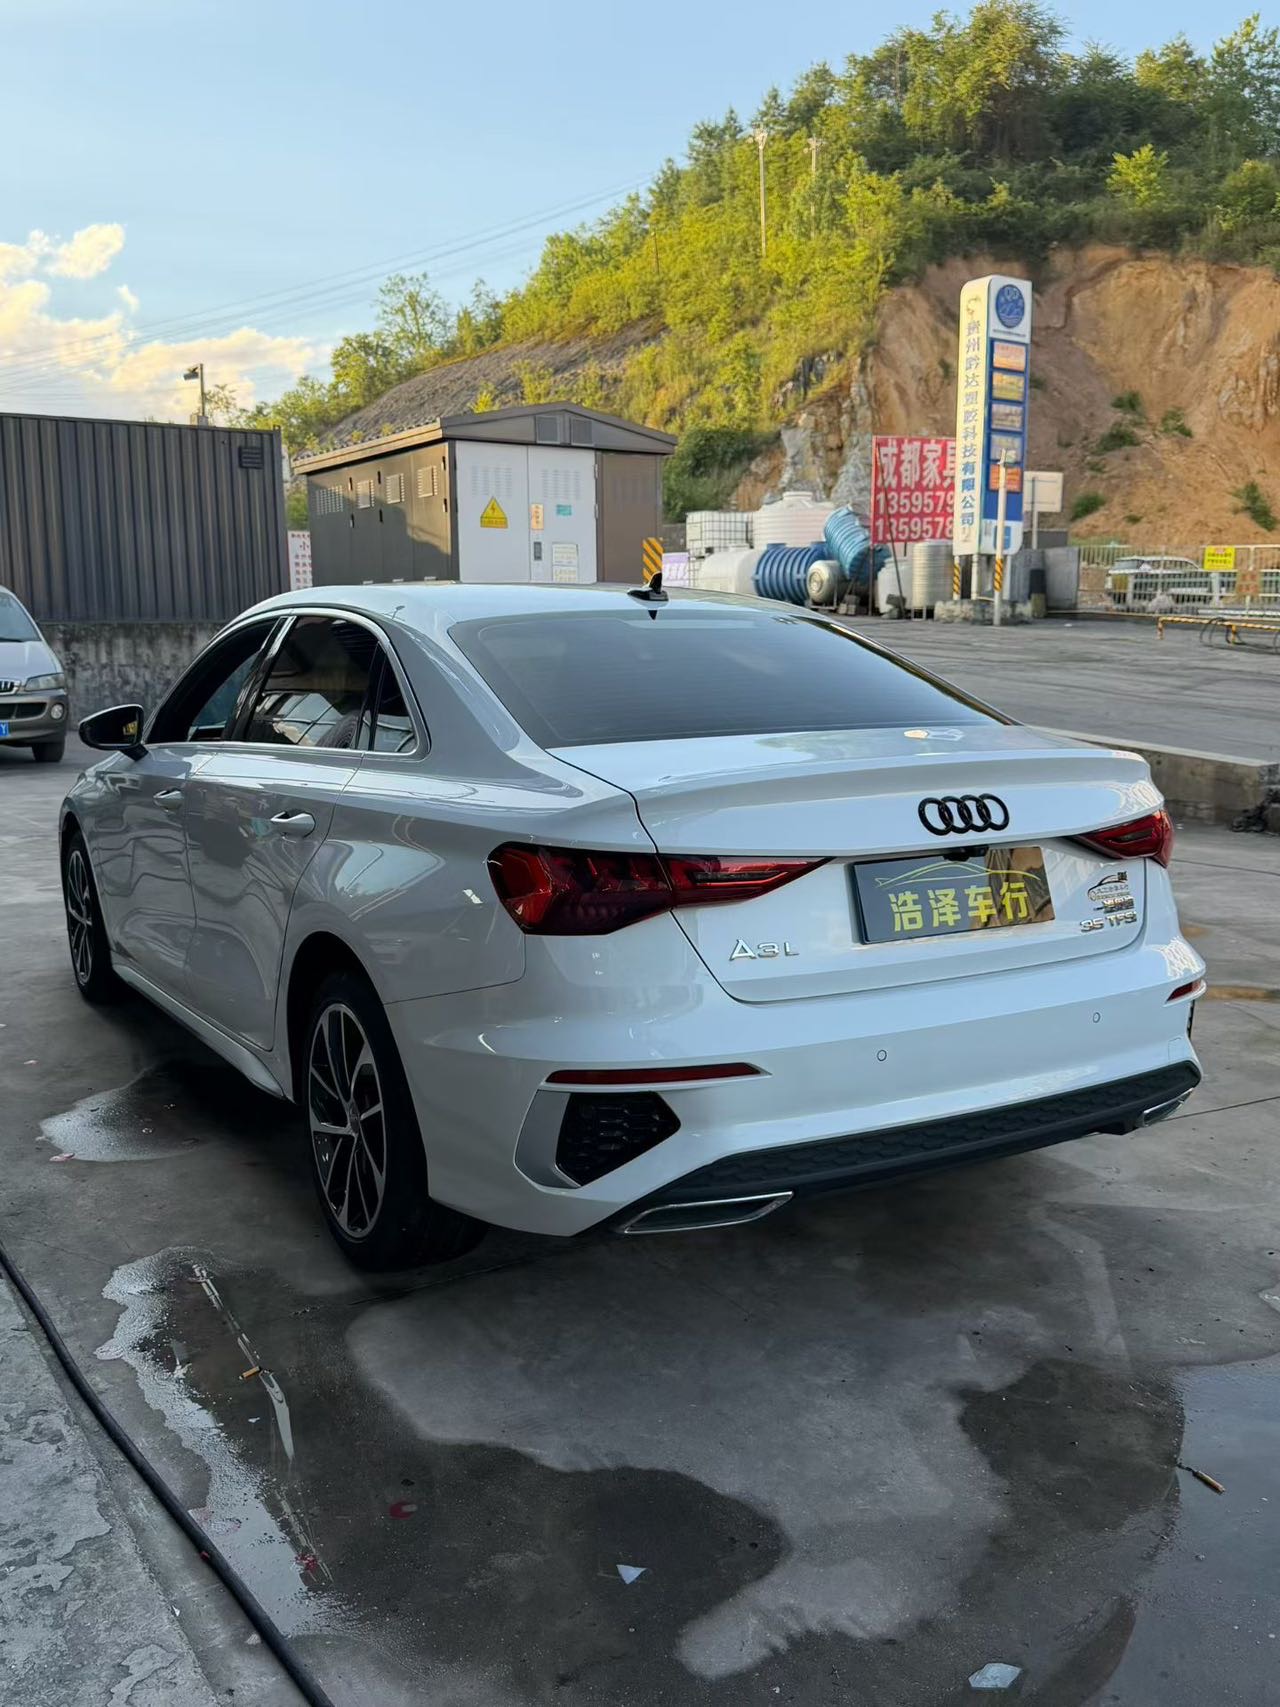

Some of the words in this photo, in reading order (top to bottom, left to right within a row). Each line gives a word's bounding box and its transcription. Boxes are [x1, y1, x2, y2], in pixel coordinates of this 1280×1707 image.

[888, 881, 1029, 932] 浩泽车行
[728, 939, 800, 961] A3L
